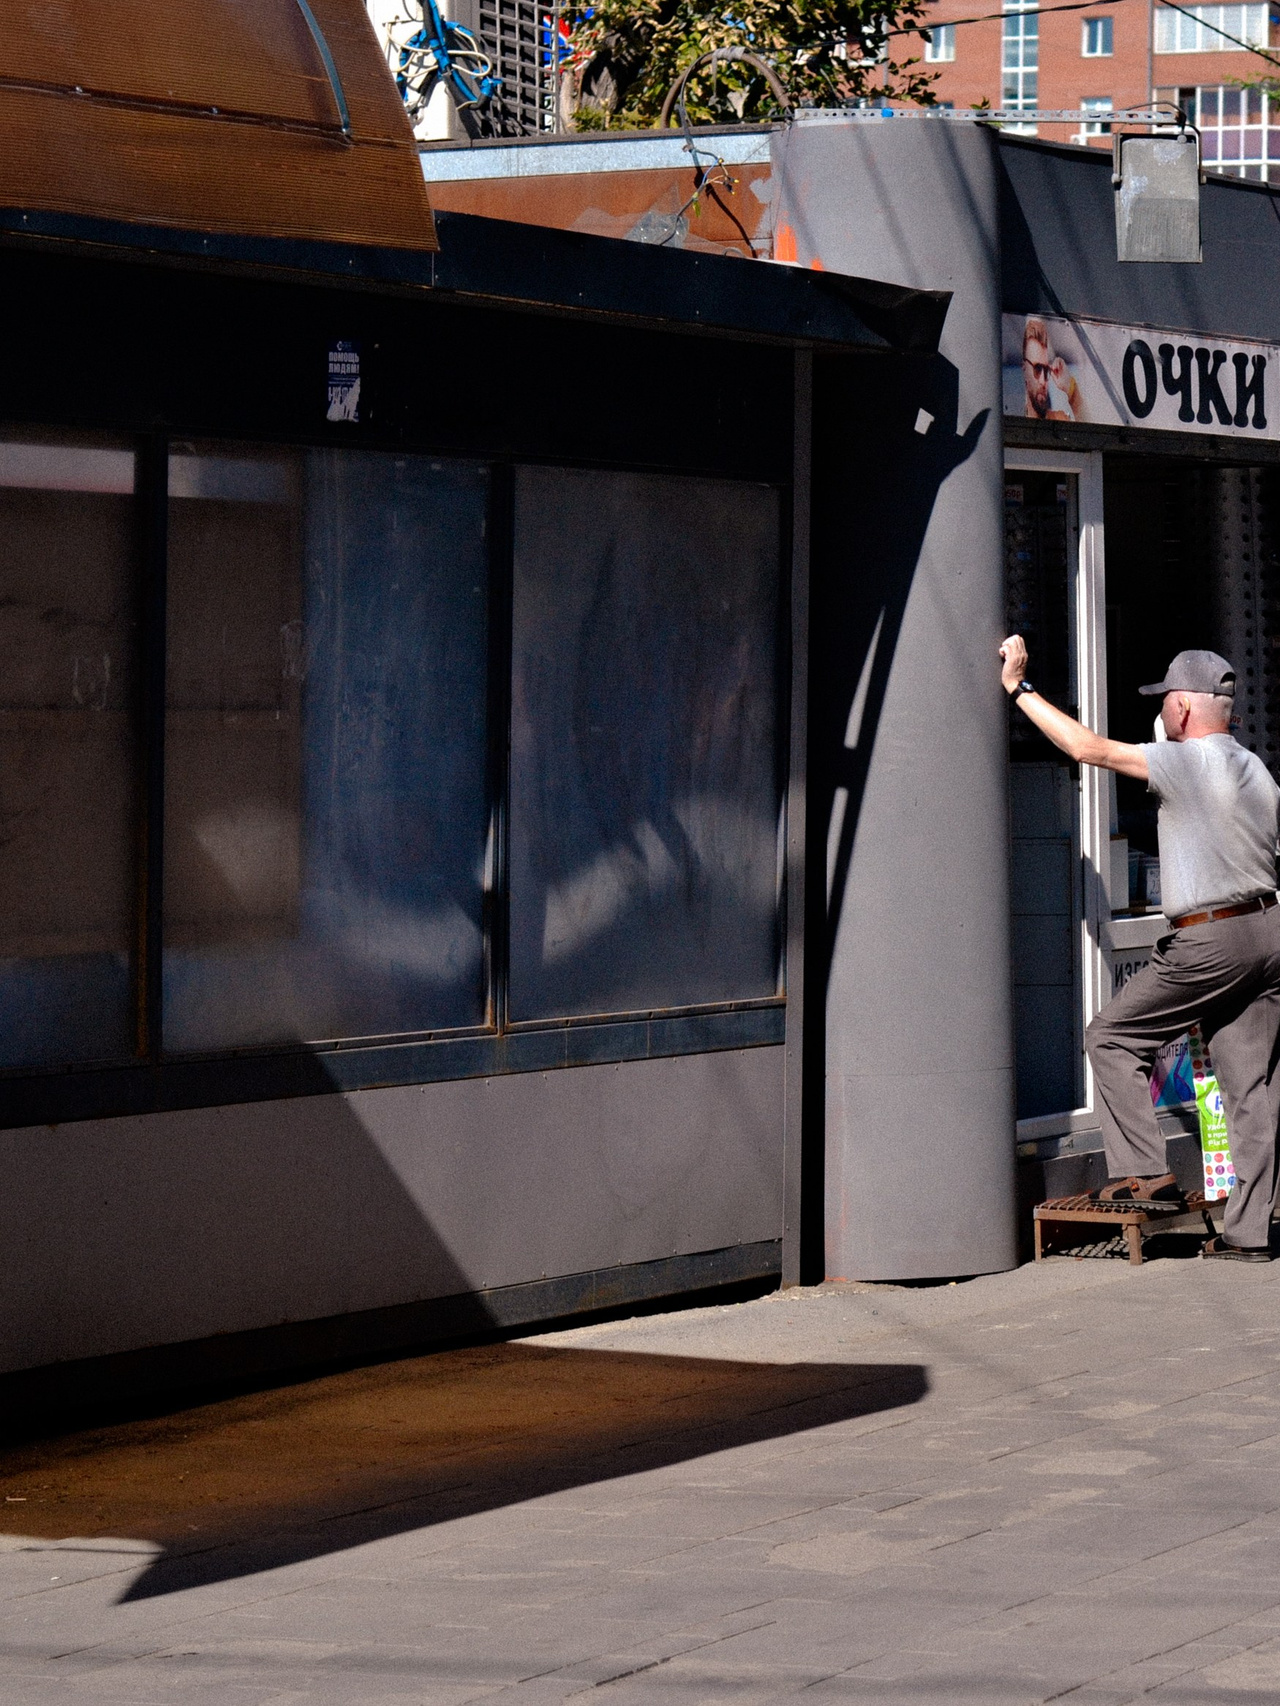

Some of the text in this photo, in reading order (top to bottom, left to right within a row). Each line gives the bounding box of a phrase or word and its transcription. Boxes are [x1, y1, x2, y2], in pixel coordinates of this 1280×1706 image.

[328, 351, 360, 363] ПОМОЩЬ
[328, 363, 360, 375] ЛЮДЯМ!
[1122, 339, 1267, 430] ОЧКИ
